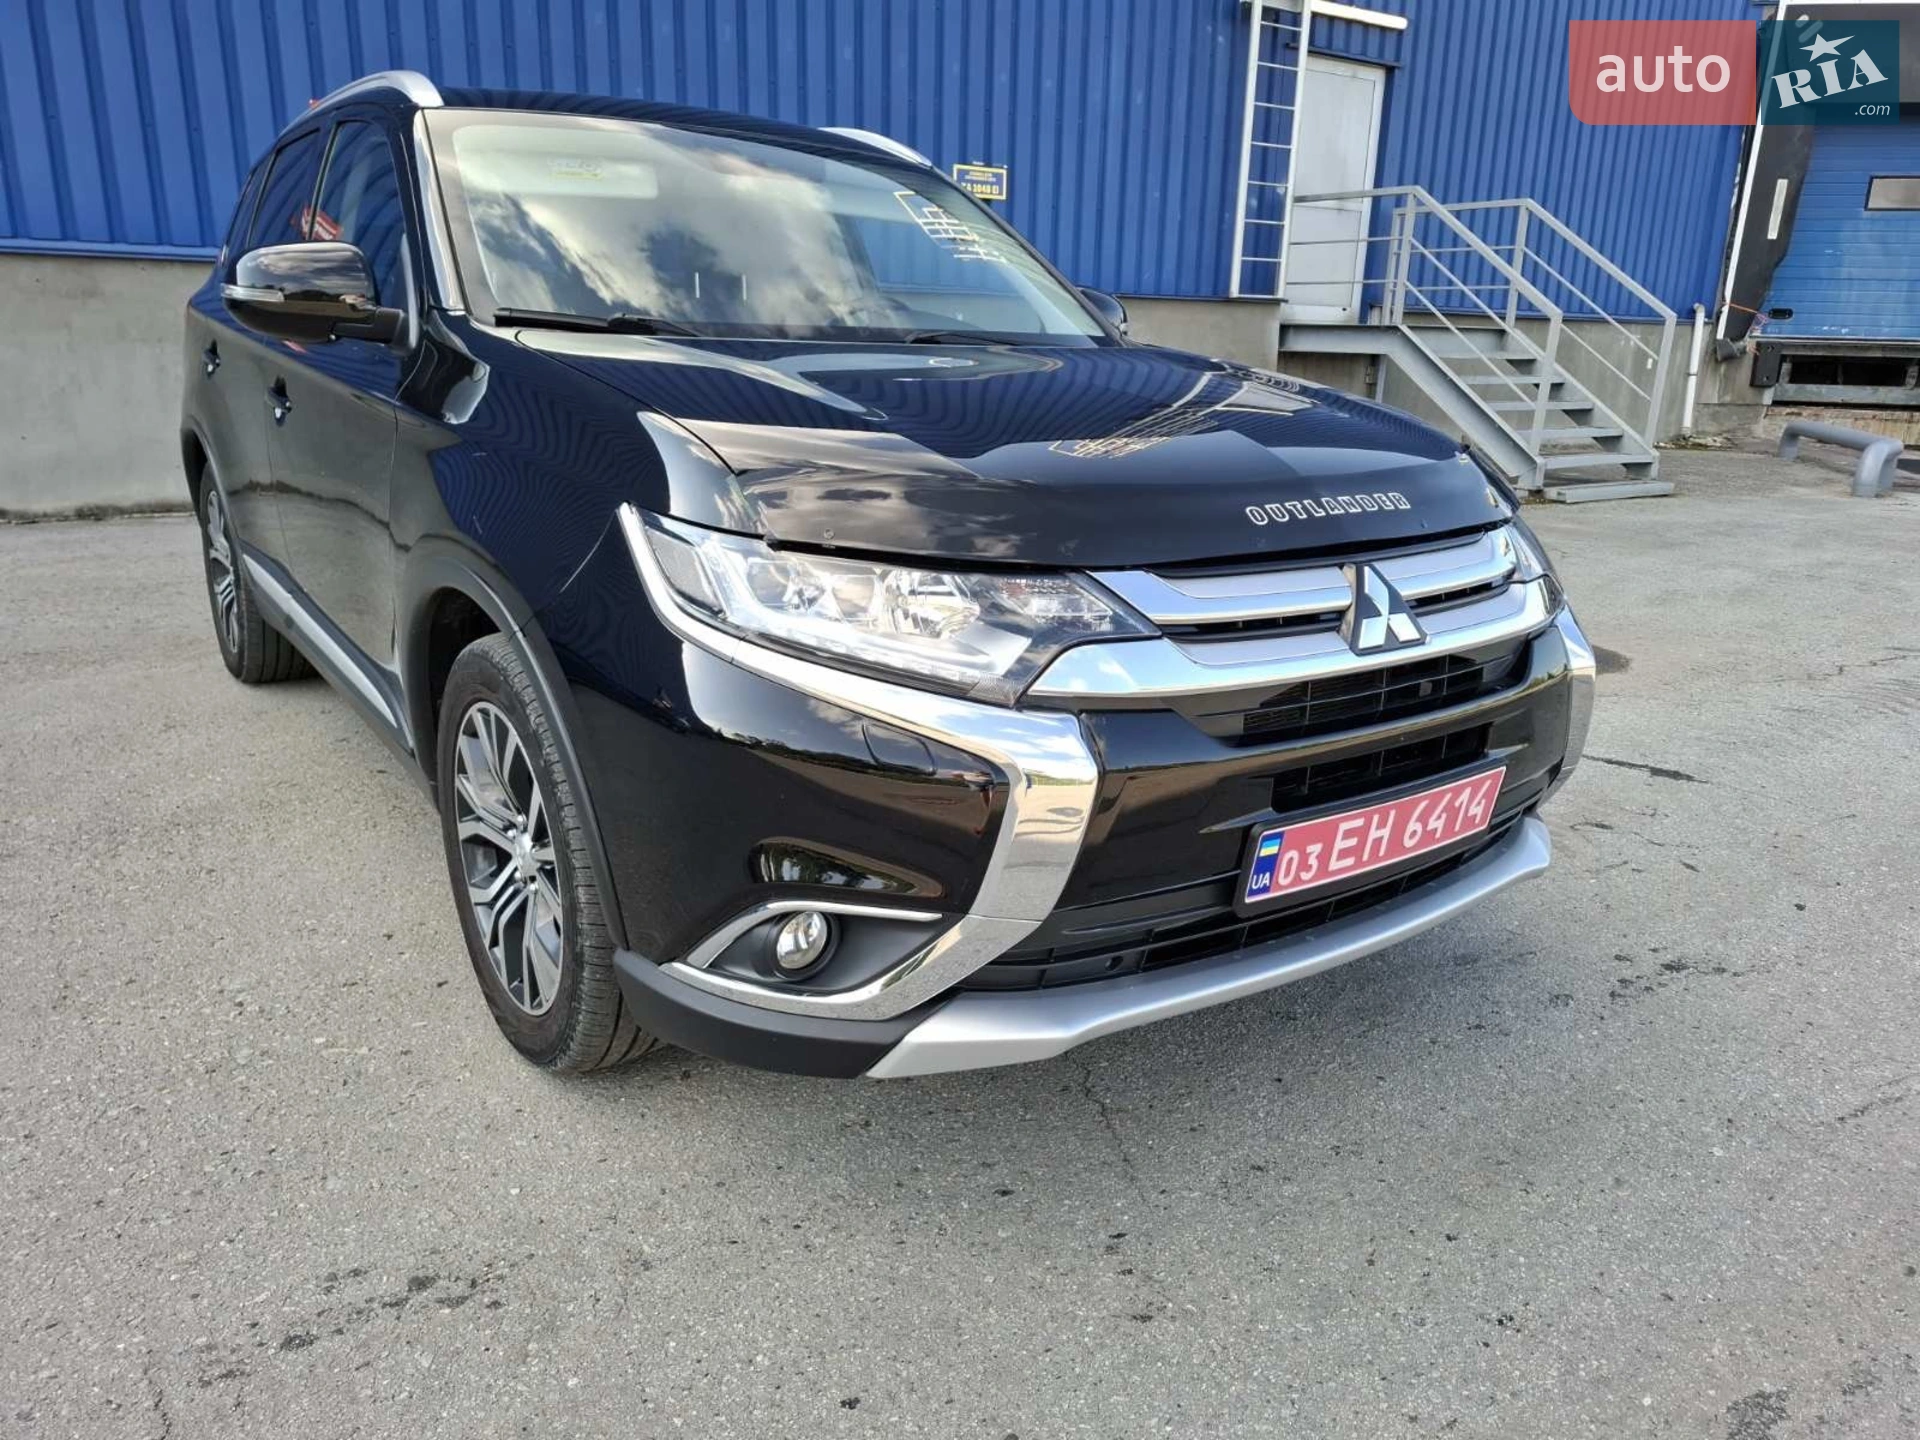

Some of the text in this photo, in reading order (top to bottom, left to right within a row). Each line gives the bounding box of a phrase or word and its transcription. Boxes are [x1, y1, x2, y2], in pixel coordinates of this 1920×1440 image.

[1245, 492, 1411, 525] OUTLANDER
[1277, 779, 1492, 887] 03 EH 6414
[1251, 874, 1271, 890] UA
